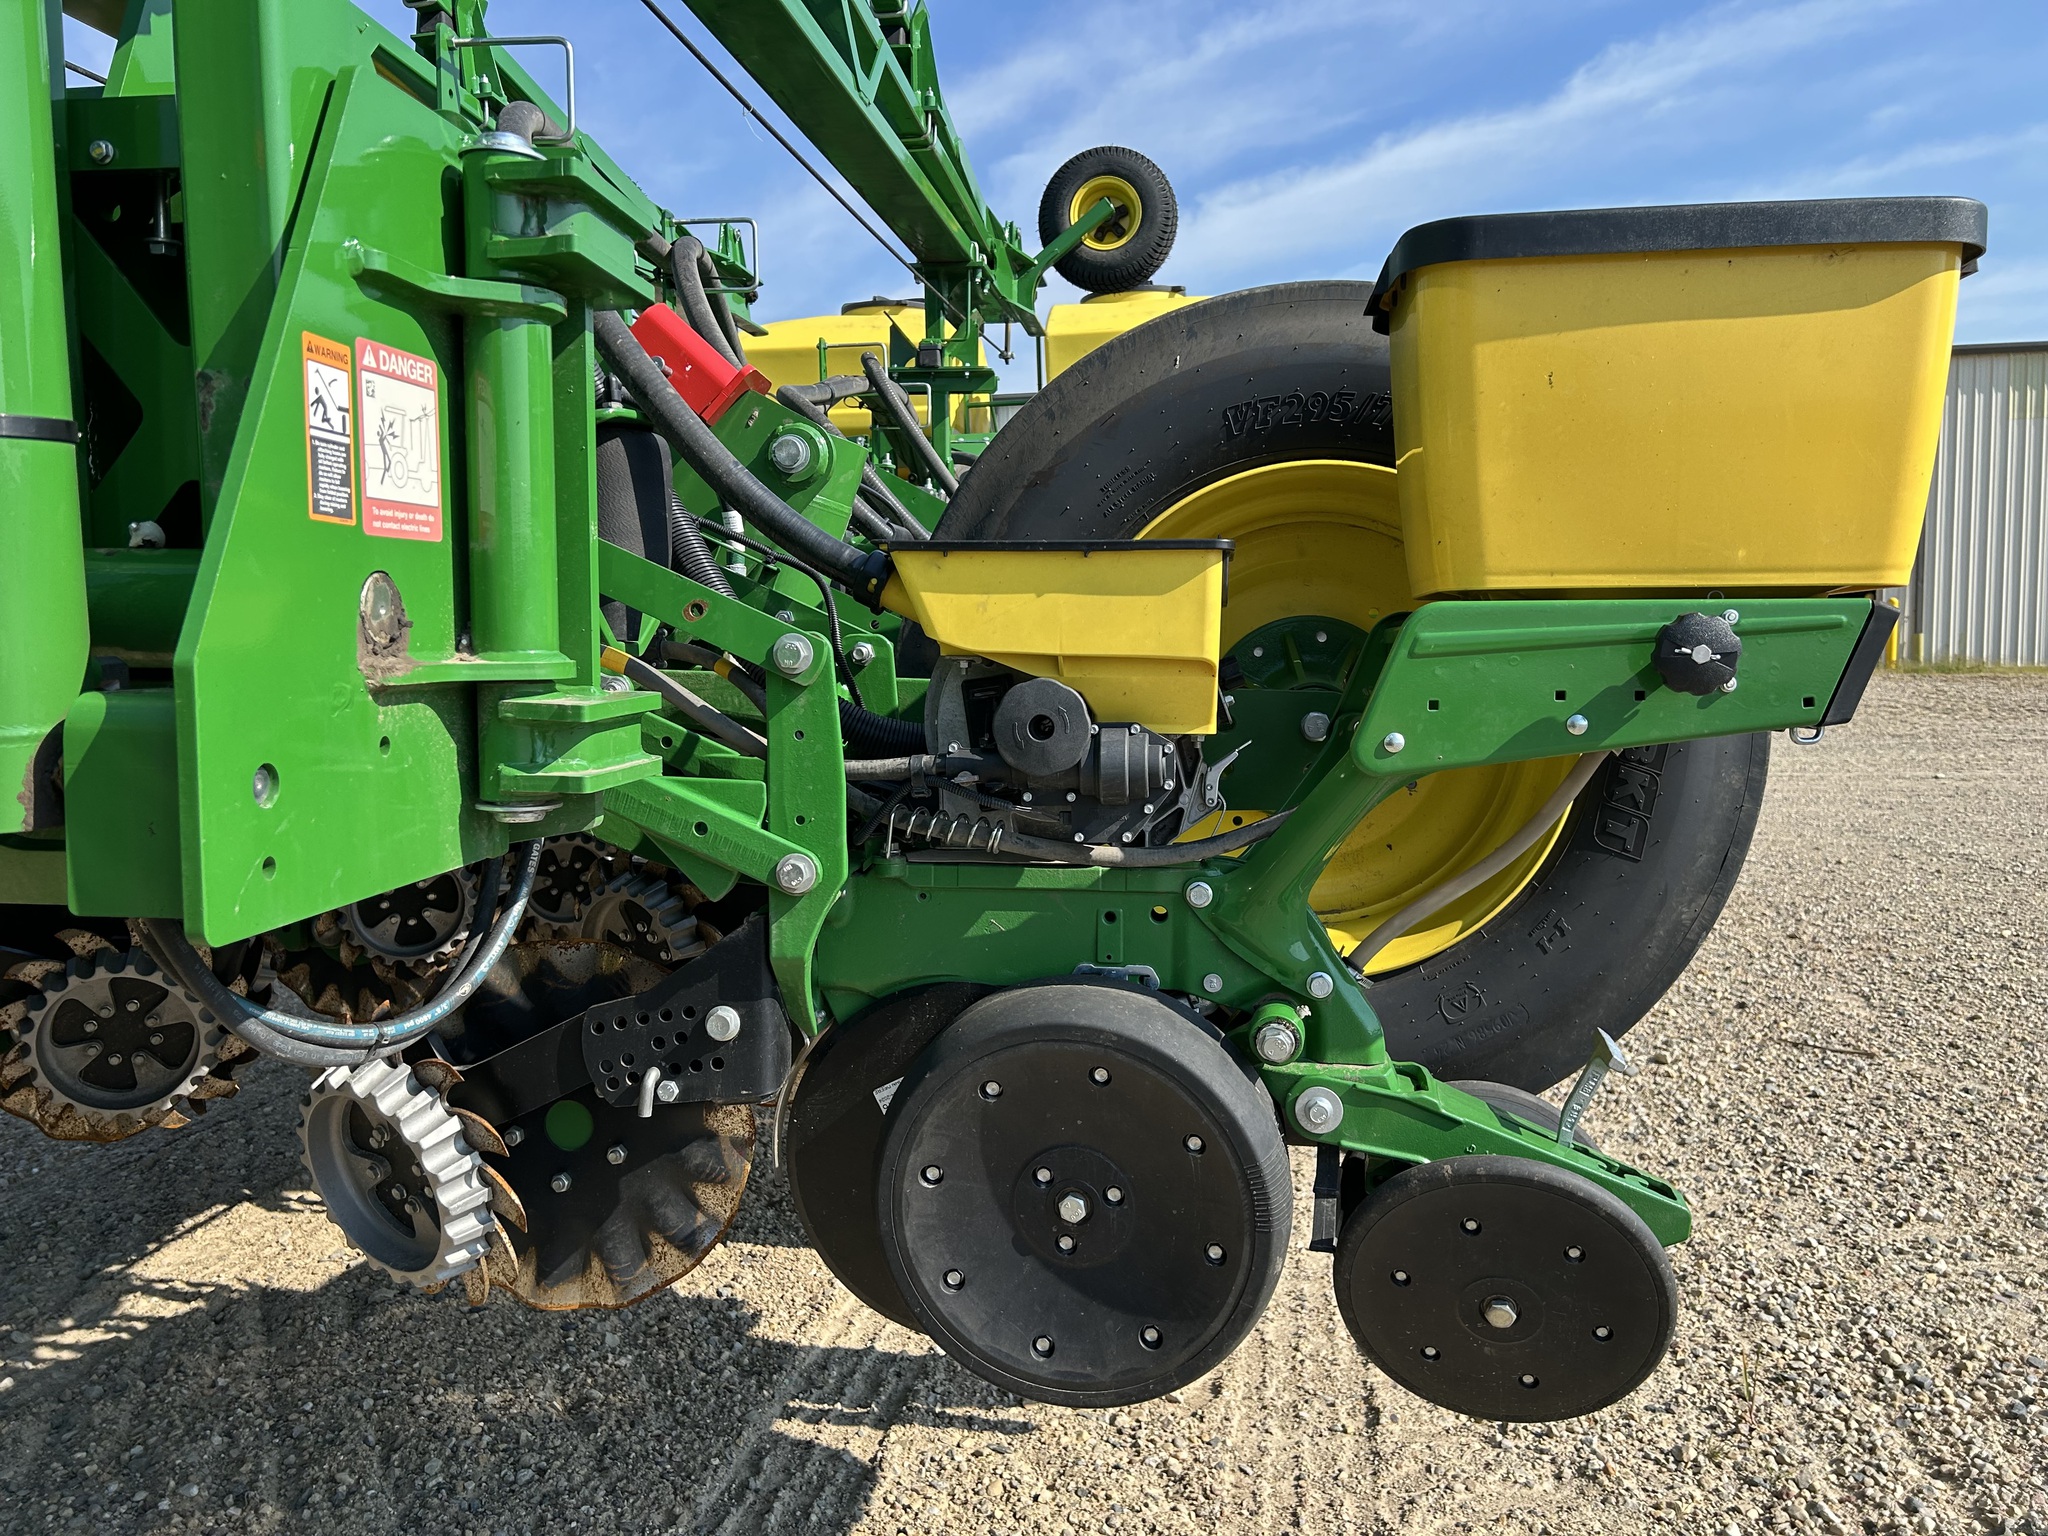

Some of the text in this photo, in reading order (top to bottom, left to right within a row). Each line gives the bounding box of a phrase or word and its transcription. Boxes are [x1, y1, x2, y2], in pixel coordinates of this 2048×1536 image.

[314, 345, 348, 365] WARNING
[379, 349, 433, 385] DANGER
[372, 506, 379, 515] To
[380, 508, 393, 517] avoid
[394, 509, 408, 520] injury
[415, 512, 427, 521] death
[428, 514, 435, 522] do
[372, 520, 431, 533] not contact electric lines
[527, 843, 541, 874] GATES
